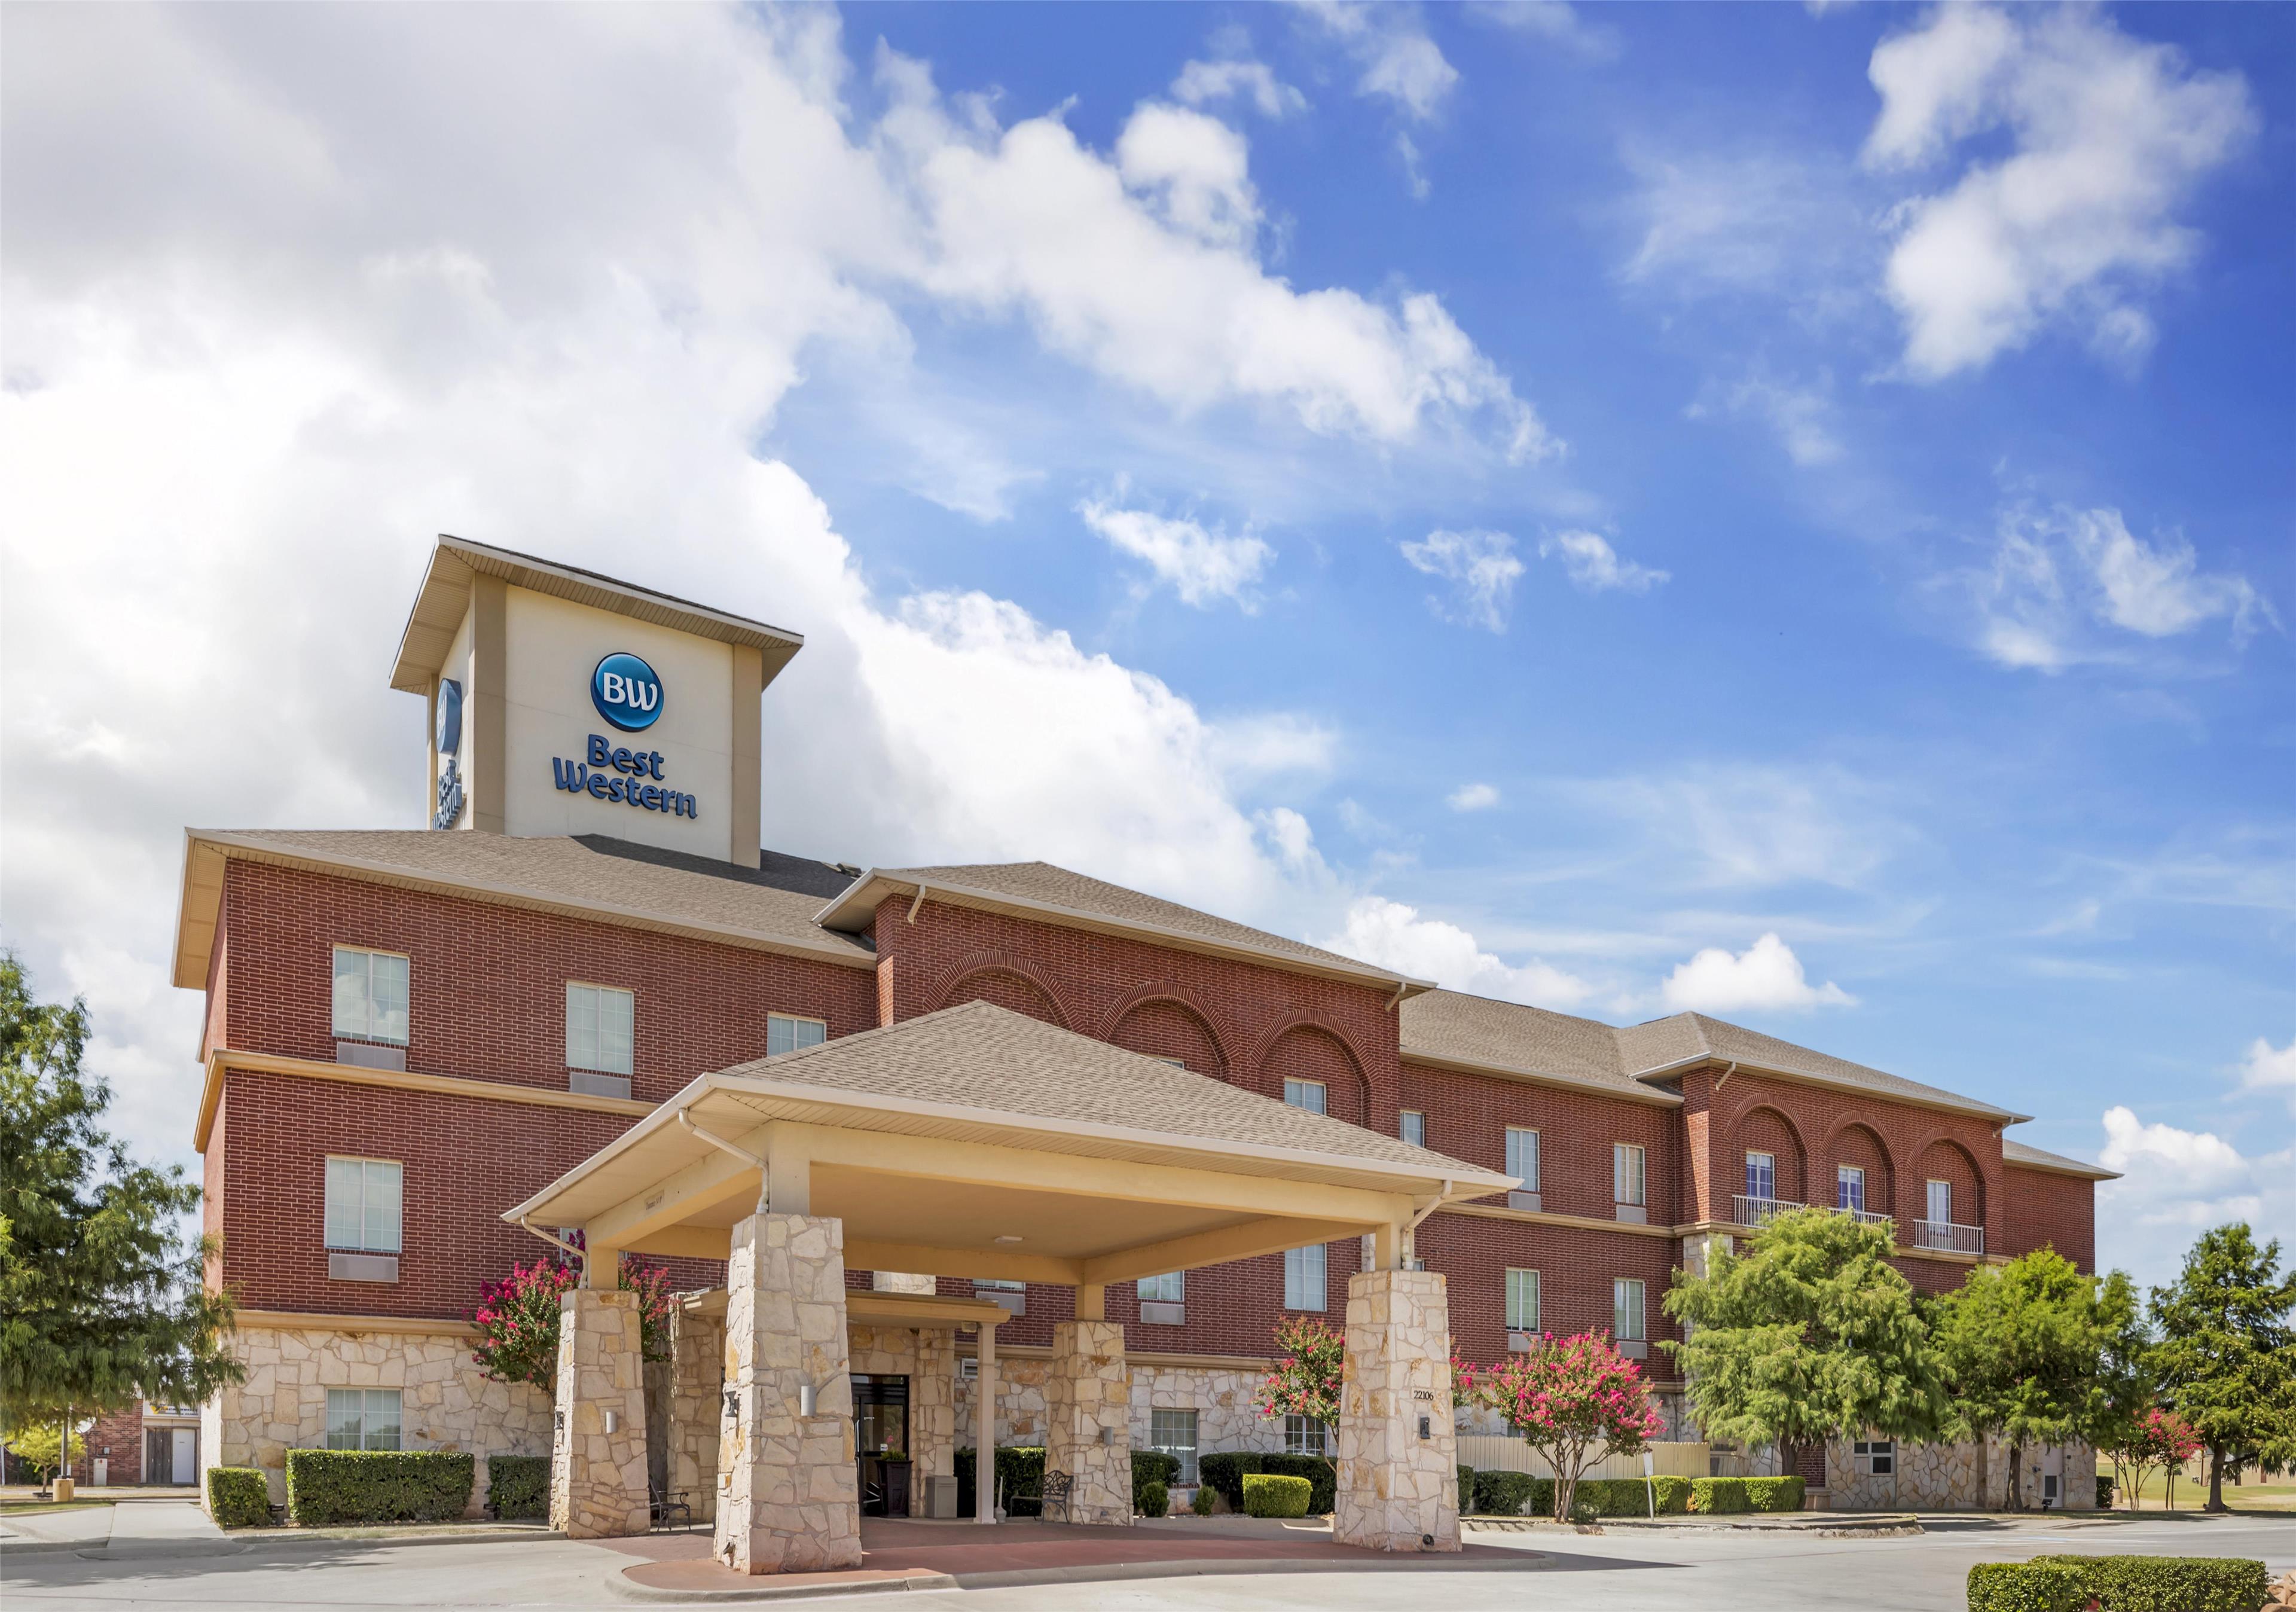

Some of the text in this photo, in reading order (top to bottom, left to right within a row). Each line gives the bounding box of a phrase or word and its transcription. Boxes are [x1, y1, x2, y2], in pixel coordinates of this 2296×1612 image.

[603, 672, 658, 711] BW
[587, 734, 665, 781] Best
[552, 756, 698, 819] Western
[1413, 1390, 1434, 1400] 22106
